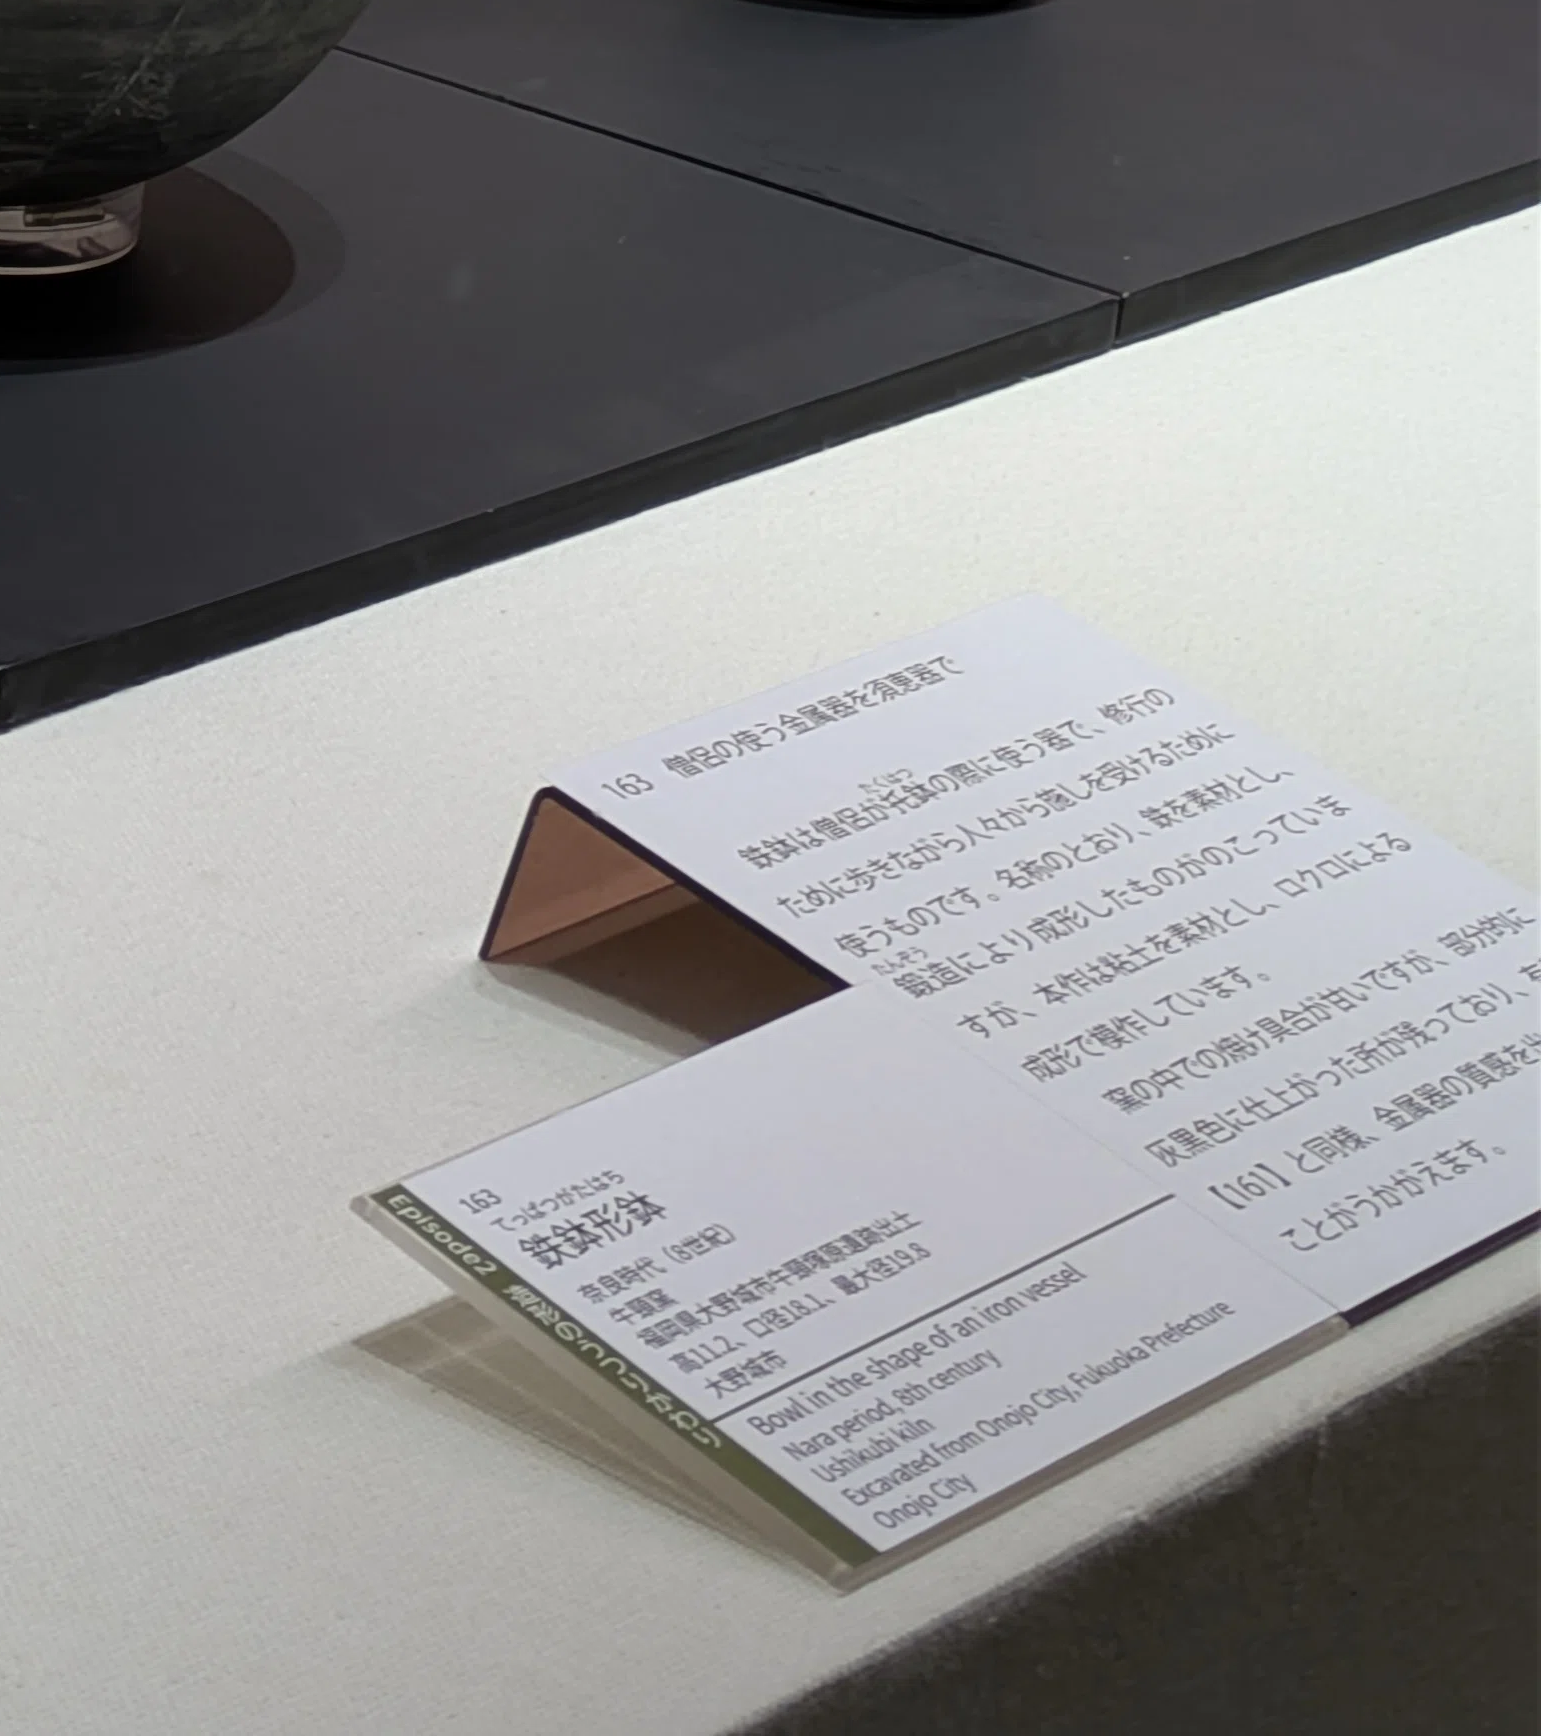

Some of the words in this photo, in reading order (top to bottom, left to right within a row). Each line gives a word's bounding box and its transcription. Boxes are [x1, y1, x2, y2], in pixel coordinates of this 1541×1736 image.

[601, 774, 654, 799] 163
[388, 1195, 496, 1274] Episode2
[459, 1189, 502, 1214] 163
[747, 1397, 814, 1435] Bowl
[799, 1391, 836, 1409] in
[825, 1372, 873, 1397] the
[866, 1342, 935, 1379] shape
[929, 1324, 956, 1348] of
[951, 1317, 985, 1337] an
[972, 1296, 1026, 1323] iron
[1018, 1262, 1087, 1302] vessel
[781, 1433, 836, 1461] Nara
[831, 1398, 904, 1442] period,
[892, 1383, 933, 1406] 8th
[928, 1350, 1002, 1390] century
[841, 1450, 941, 1506] Excavated
[929, 1432, 985, 1459] from
[976, 1404, 1038, 1437] Onojo
[1030, 1385, 1082, 1409] City,
[1068, 1346, 1151, 1389] Fukuoka
[1139, 1303, 1235, 1352] Prefecture
[811, 1433, 900, 1482] Ushikubi
[890, 1419, 936, 1442] kiln
[873, 1495, 937, 1528] Onojo
[930, 1474, 977, 1499] City
